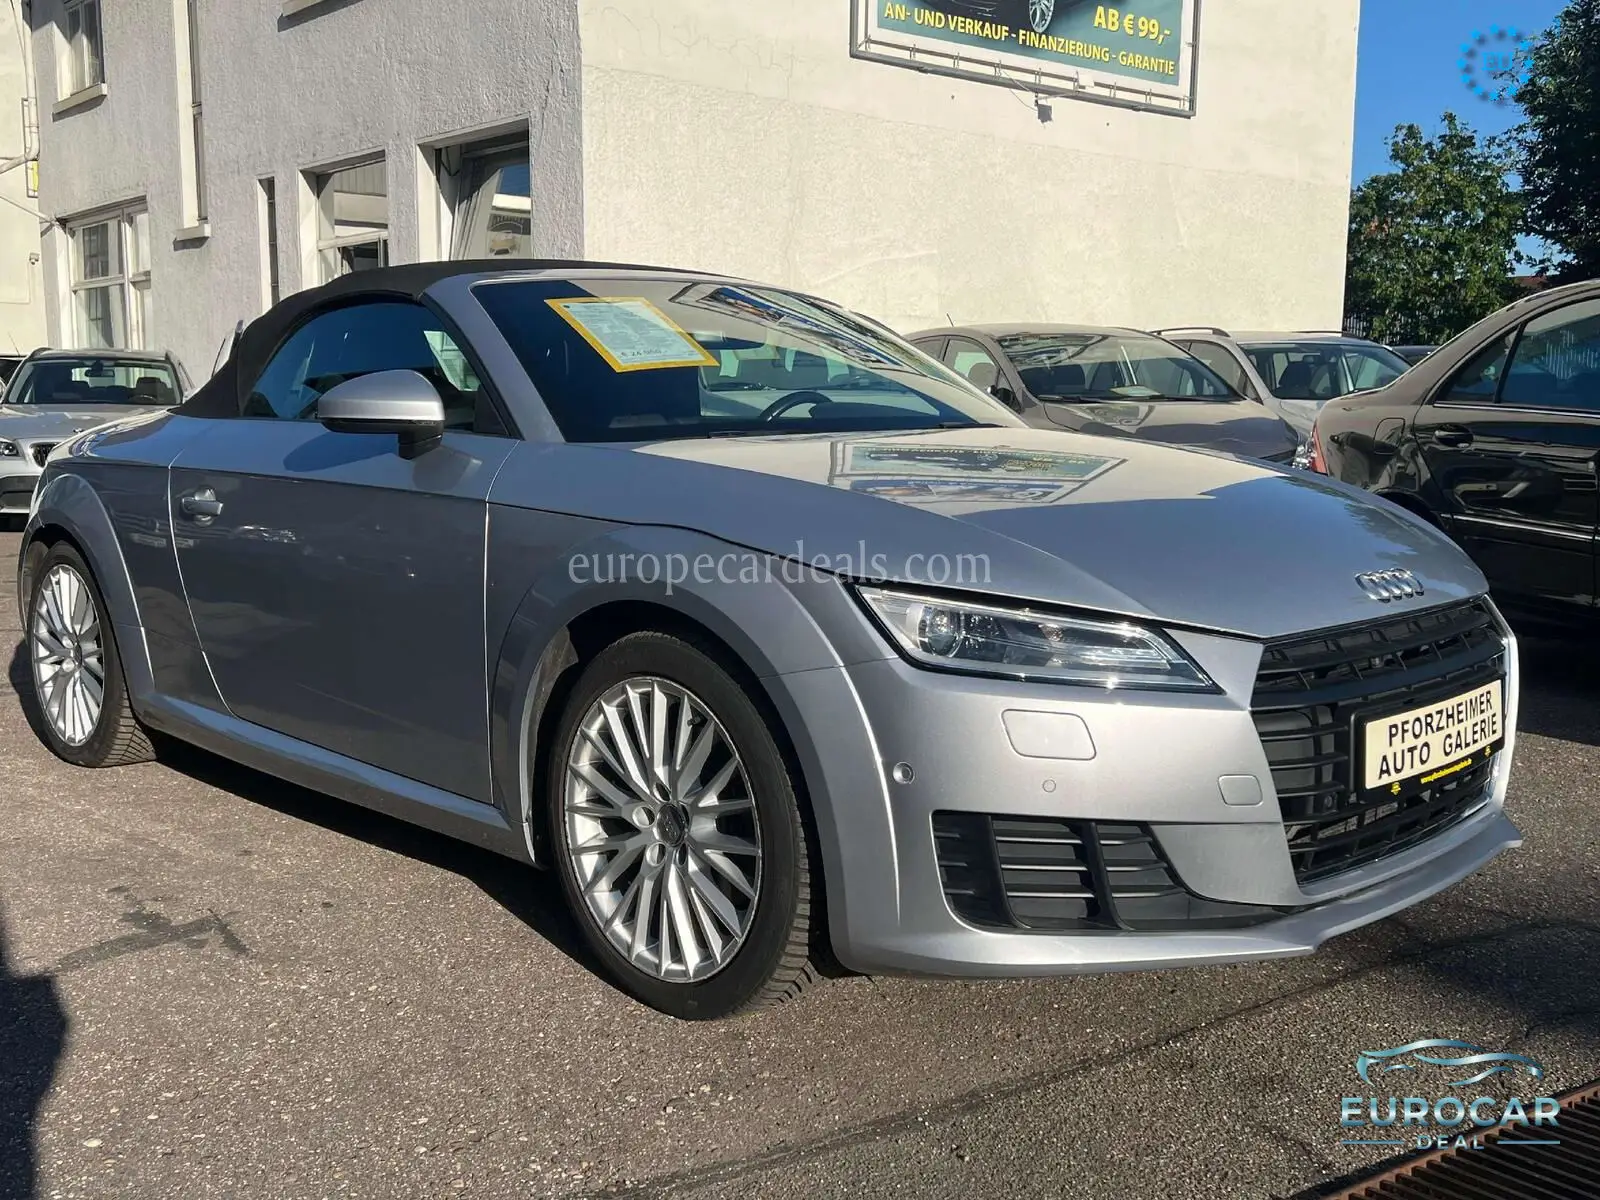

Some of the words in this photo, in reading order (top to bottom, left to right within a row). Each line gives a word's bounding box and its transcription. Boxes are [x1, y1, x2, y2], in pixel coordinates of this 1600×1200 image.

[884, 3, 911, 21] AN-
[914, 8, 945, 29] UND
[948, 15, 1009, 41] VERKAUF
[1018, 29, 1110, 62] FINANZIERUNG
[1119, 51, 1175, 75] GARANTIE
[1093, 6, 1119, 31] AB
[1123, 14, 1135, 36] €
[1138, 16, 1171, 45] 99,-
[1378, 741, 1431, 780] AUTO
[1443, 713, 1497, 757] GALERIE
[1388, 690, 1493, 748] PFORZHEIMER
